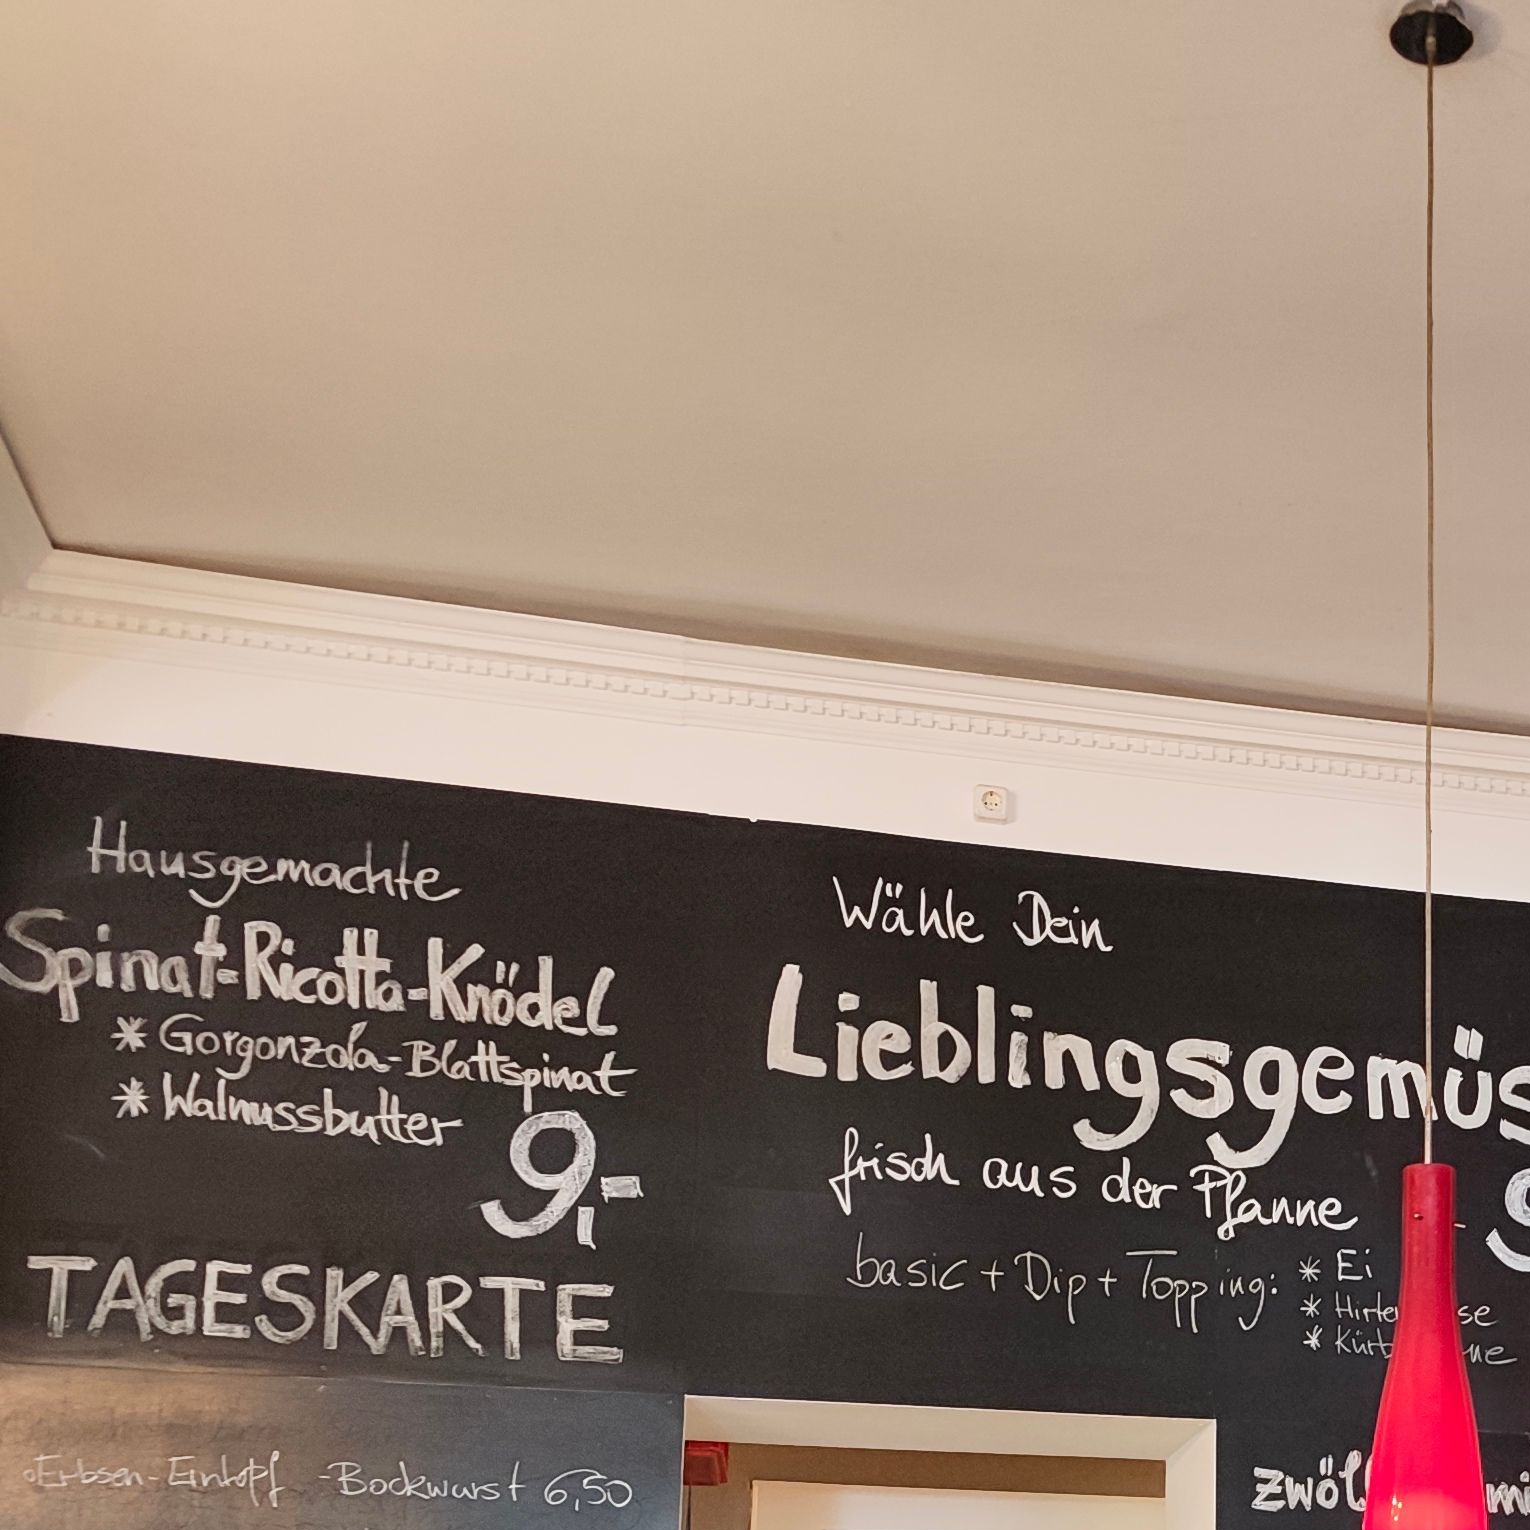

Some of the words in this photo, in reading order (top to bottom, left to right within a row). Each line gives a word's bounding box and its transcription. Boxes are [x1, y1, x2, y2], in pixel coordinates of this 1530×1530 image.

[86, 816, 463, 909] Hausgemachte
[832, 876, 985, 945] Wähle
[1011, 889, 1114, 953] Dein
[163, 1071, 465, 1147] Walnussbutter
[828, 1126, 960, 1216] frisch
[981, 1157, 1077, 1200] aus
[1100, 1157, 1178, 1210] der
[1189, 1164, 1359, 1240] Pfanne
[846, 1232, 968, 1291] basic
[1013, 1250, 1088, 1325] Dip
[1125, 1248, 1280, 1333] Topping:
[1336, 1248, 1374, 1282] Ei
[26, 1254, 625, 1364] TAGESKARTE
[543, 1468, 633, 1512] 6,50
[1251, 1449, 1371, 1514] zwöl
